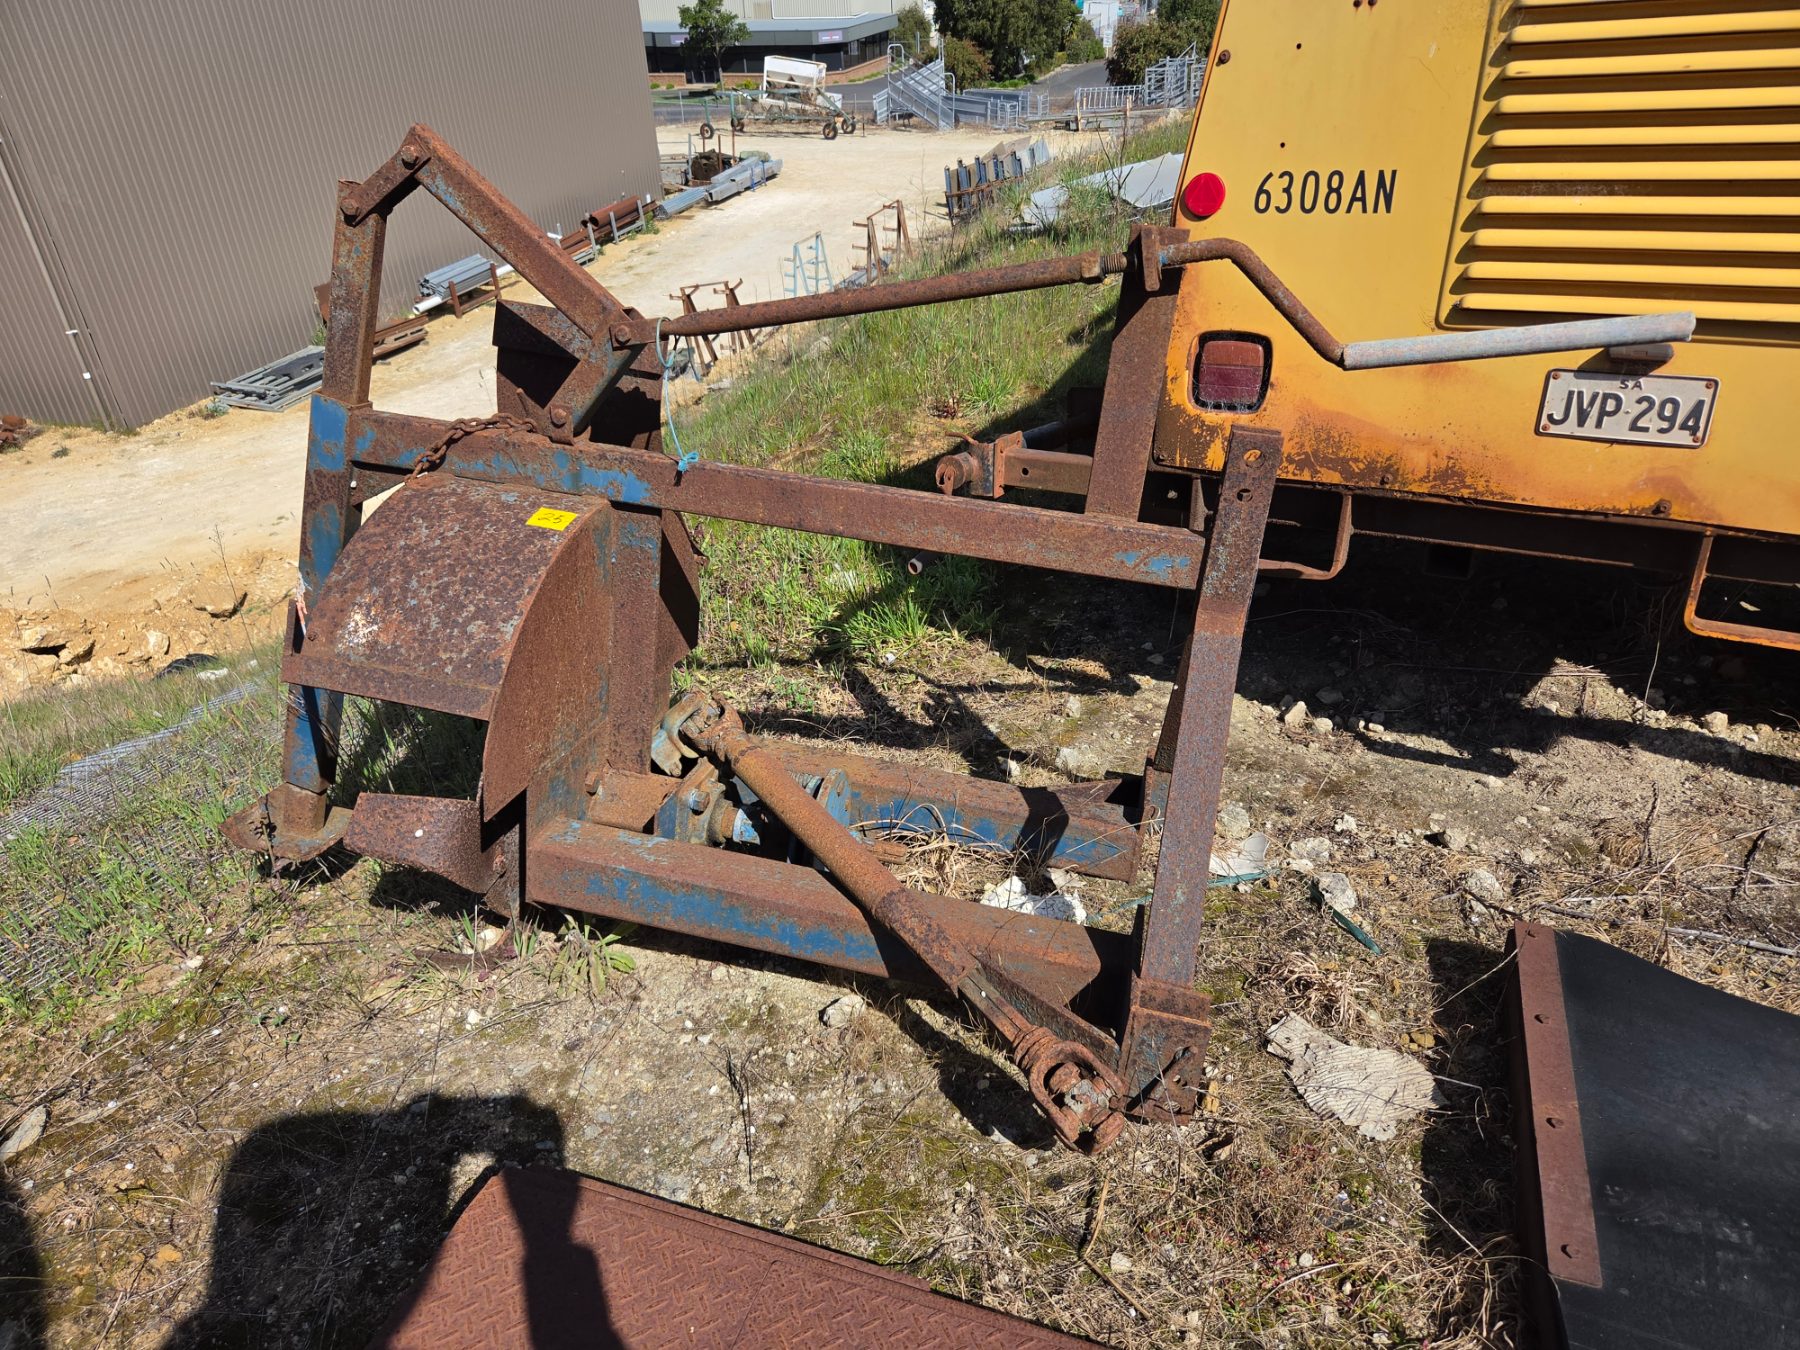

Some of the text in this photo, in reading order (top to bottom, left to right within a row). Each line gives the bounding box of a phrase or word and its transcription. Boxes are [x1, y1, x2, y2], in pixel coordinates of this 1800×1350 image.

[1254, 169, 1398, 214] 6308AN
[1619, 379, 1643, 391] SA
[537, 512, 565, 524] 25
